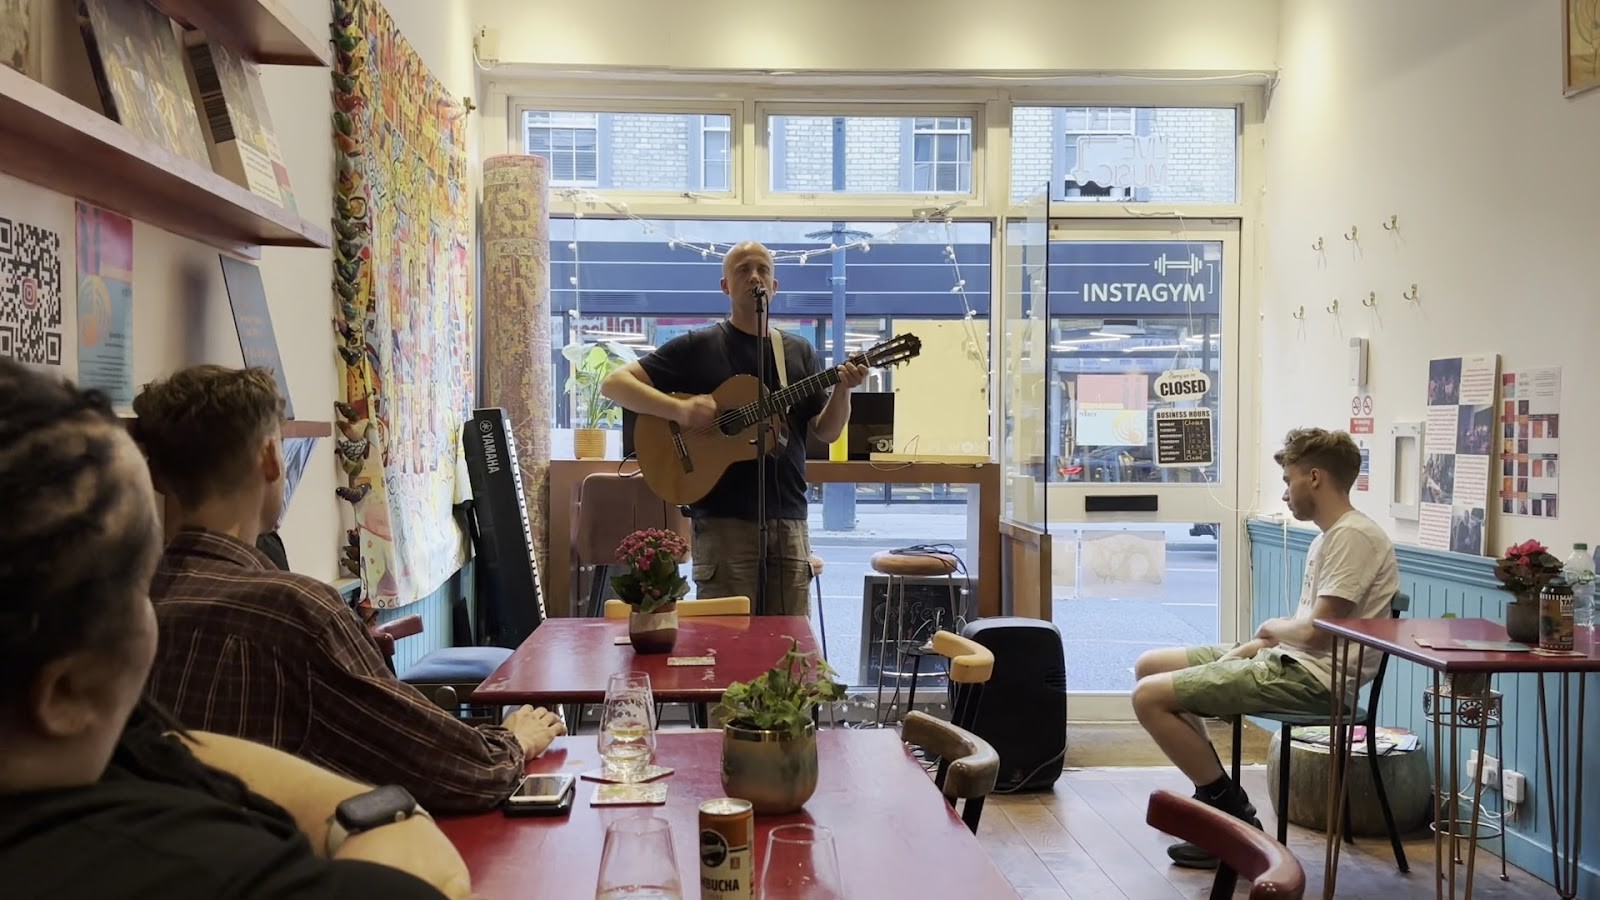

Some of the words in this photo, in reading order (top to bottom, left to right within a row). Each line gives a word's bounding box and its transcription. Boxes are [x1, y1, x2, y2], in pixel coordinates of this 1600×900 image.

[1083, 282, 1205, 303] INSTAGYM
[1160, 379, 1207, 397] CLOSED
[1156, 411, 1187, 419] BUSINESS
[1188, 410, 1210, 418] HOURS
[482, 432, 500, 474] YAMAHA
